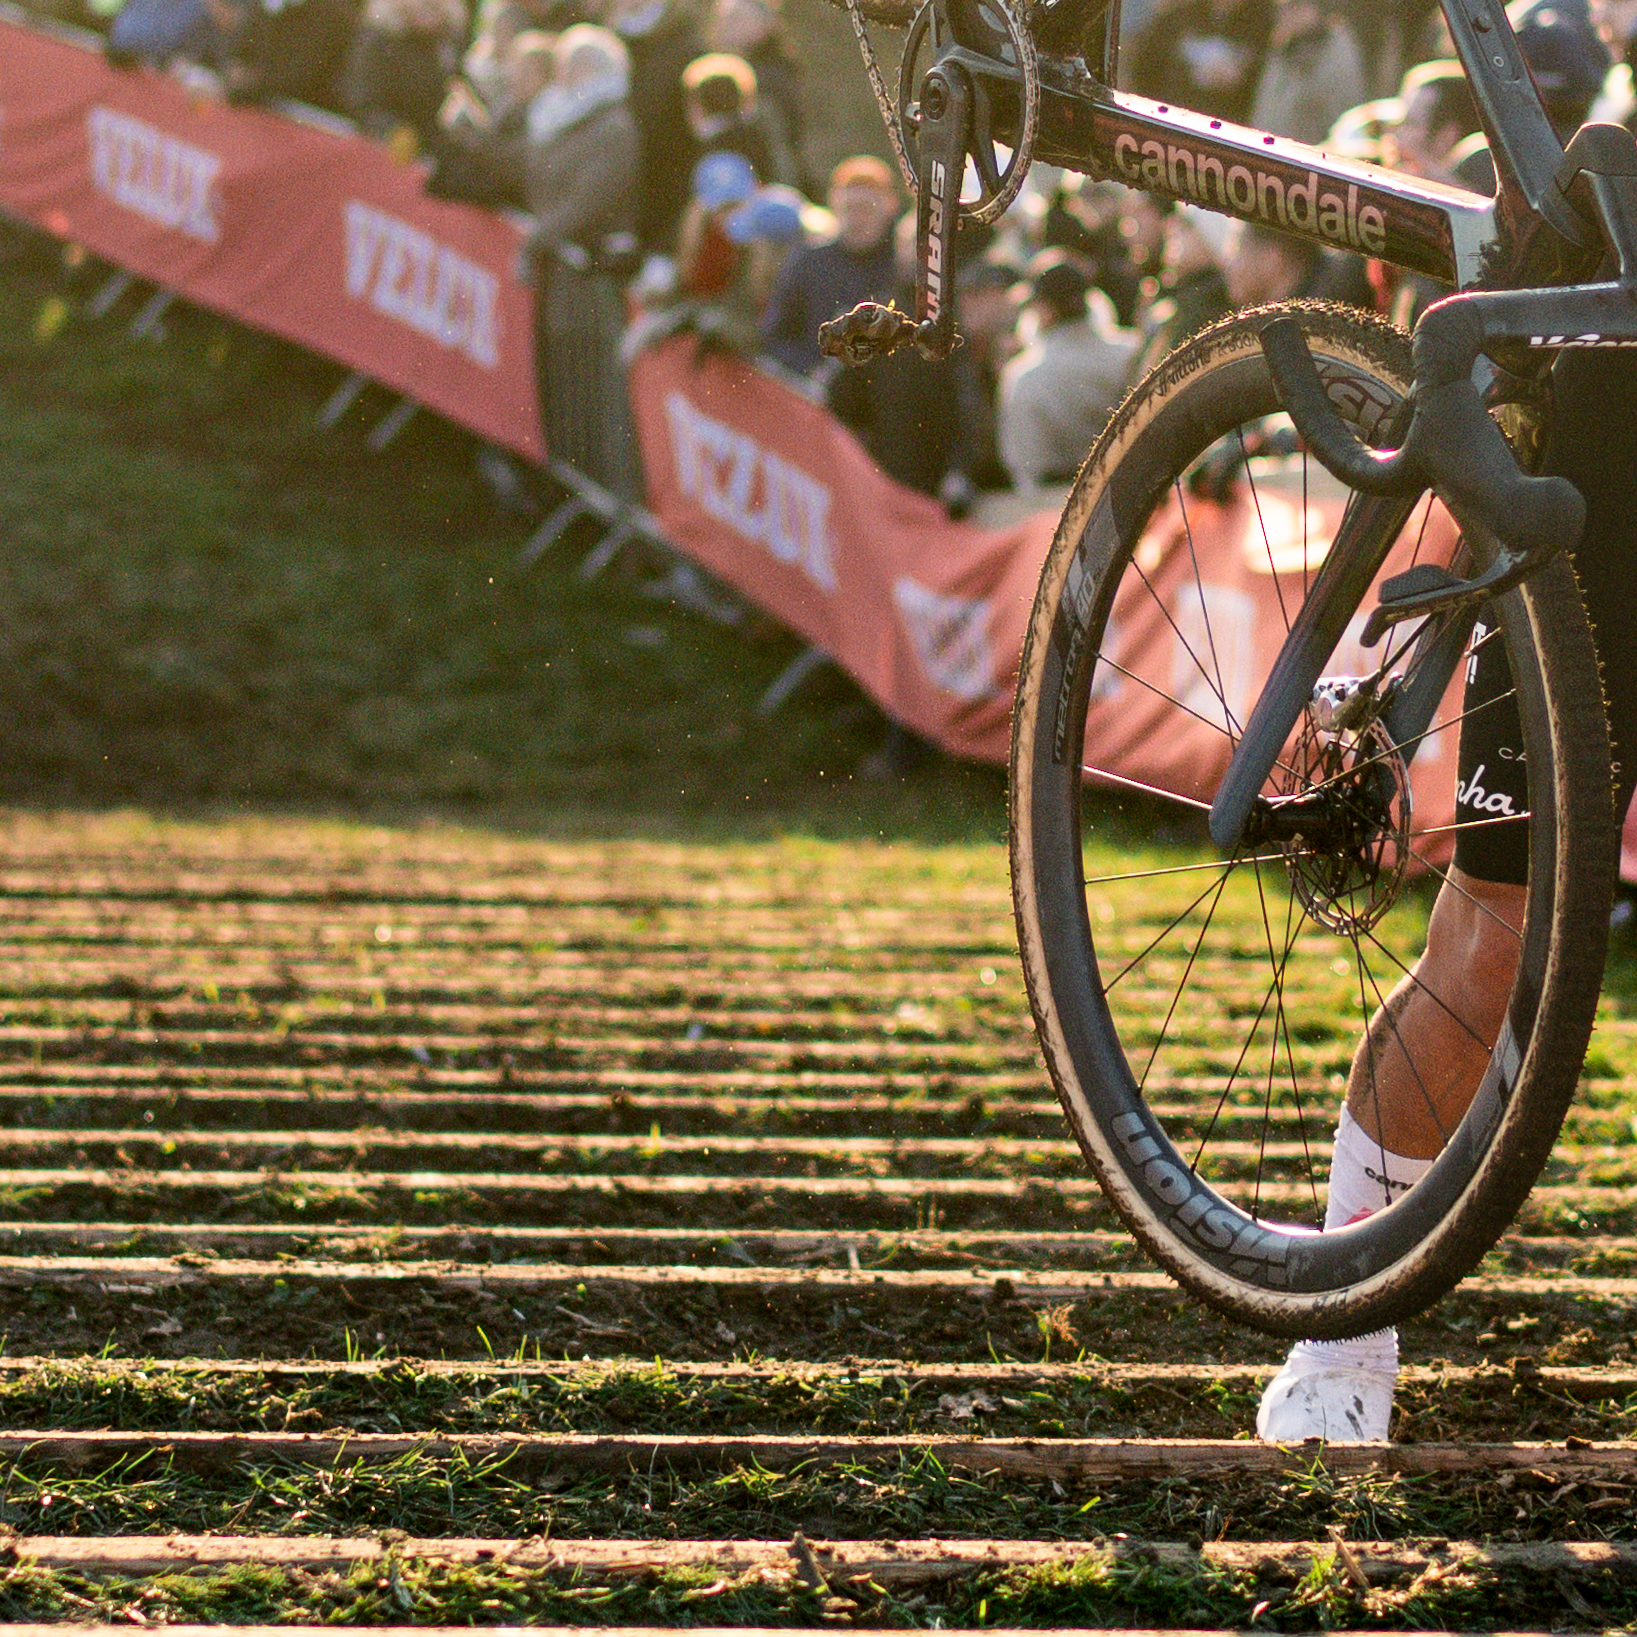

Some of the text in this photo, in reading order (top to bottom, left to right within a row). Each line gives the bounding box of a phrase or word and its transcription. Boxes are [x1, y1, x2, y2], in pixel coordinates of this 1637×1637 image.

[86, 106, 222, 243] VELUX
[1114, 132, 1387, 252] cannondale
[344, 199, 503, 366] VELUX
